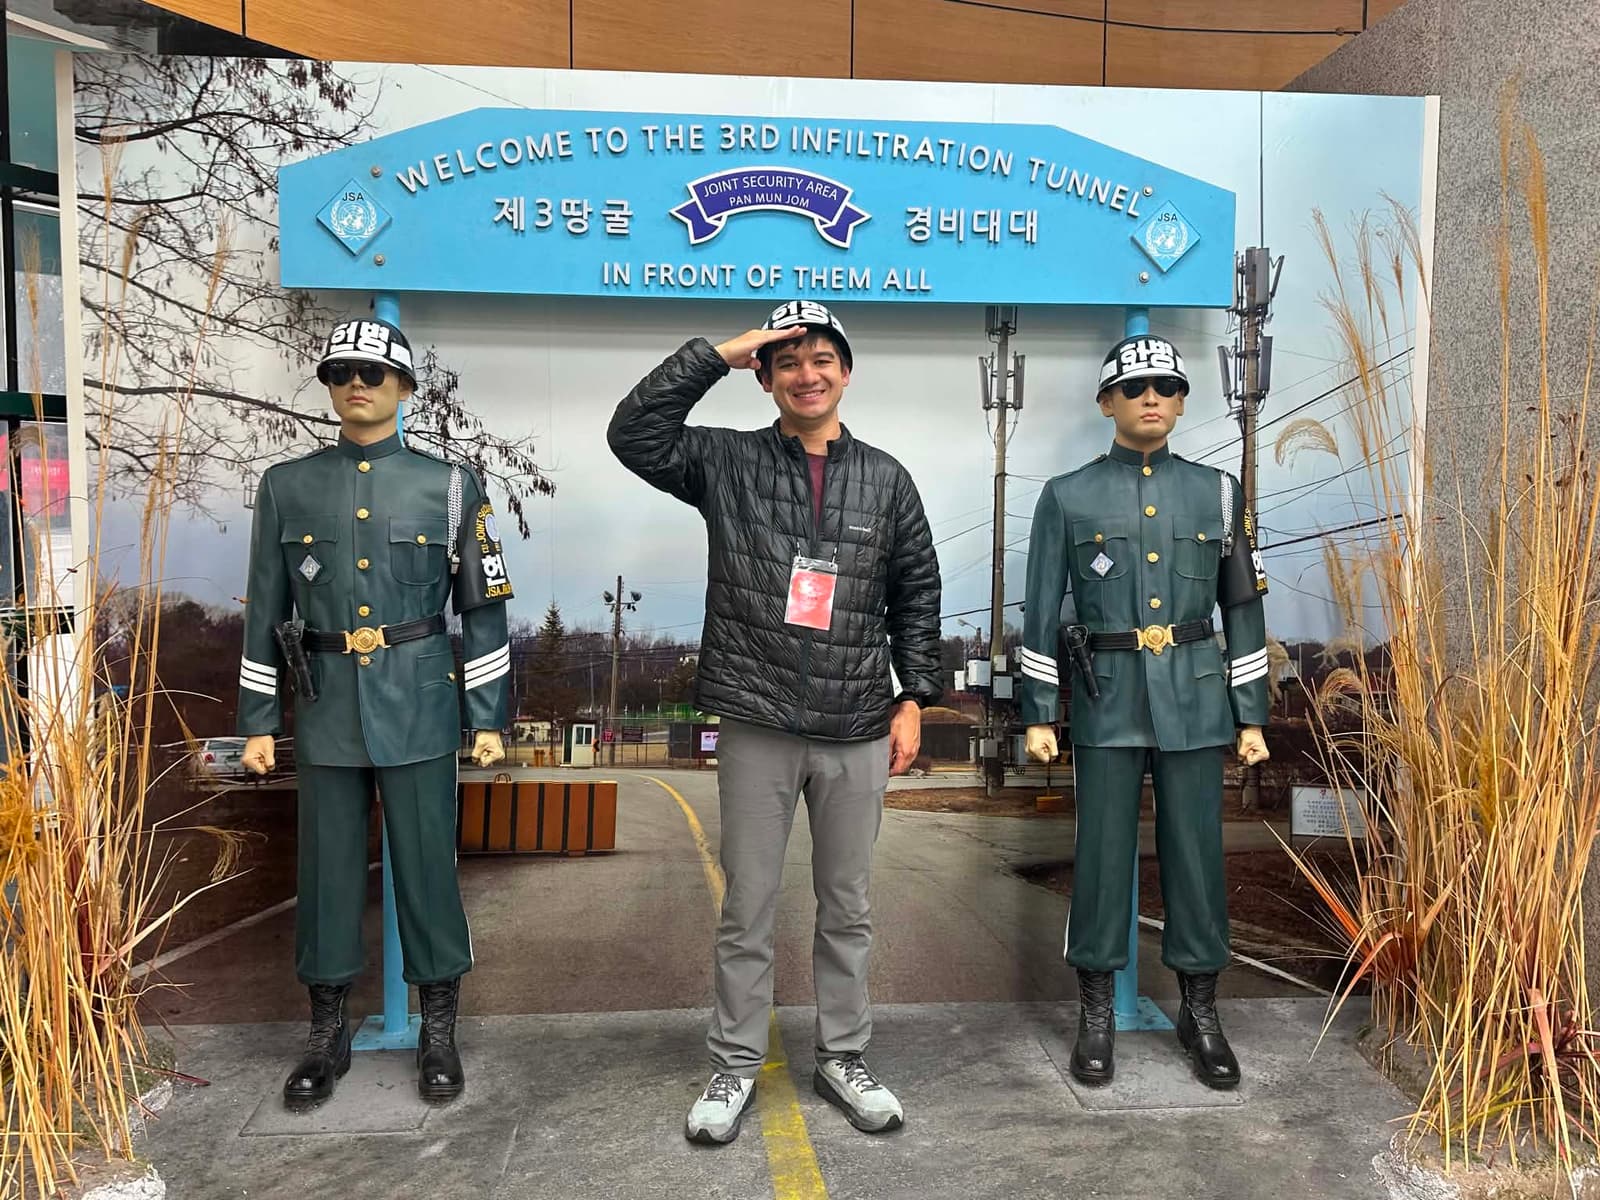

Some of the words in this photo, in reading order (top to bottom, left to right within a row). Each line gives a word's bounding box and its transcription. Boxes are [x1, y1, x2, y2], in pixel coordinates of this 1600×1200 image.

[395, 130, 574, 193] WELCOME
[585, 126, 628, 153] TO
[641, 124, 704, 151] THE
[719, 123, 780, 150] 3RD
[790, 126, 1014, 176] INFILTRATION
[1029, 157, 1141, 217] TUNNEL
[342, 191, 364, 202] JSA
[704, 178, 739, 197] JOINT
[743, 175, 804, 190] SECURITY
[805, 181, 838, 201] AREA
[729, 193, 751, 207] PAN
[755, 193, 782, 204] MUN
[785, 194, 810, 208] JOM
[905, 206, 1038, 243] 경비대대
[1157, 212, 1178, 222] JSA
[602, 262, 631, 286] IN
[643, 262, 736, 288] FRONT
[746, 264, 782, 288] OF
[793, 266, 871, 290] THEM
[882, 268, 932, 291] ALL
[330, 321, 389, 356] 헌병
[1120, 339, 1175, 374] 헌병
